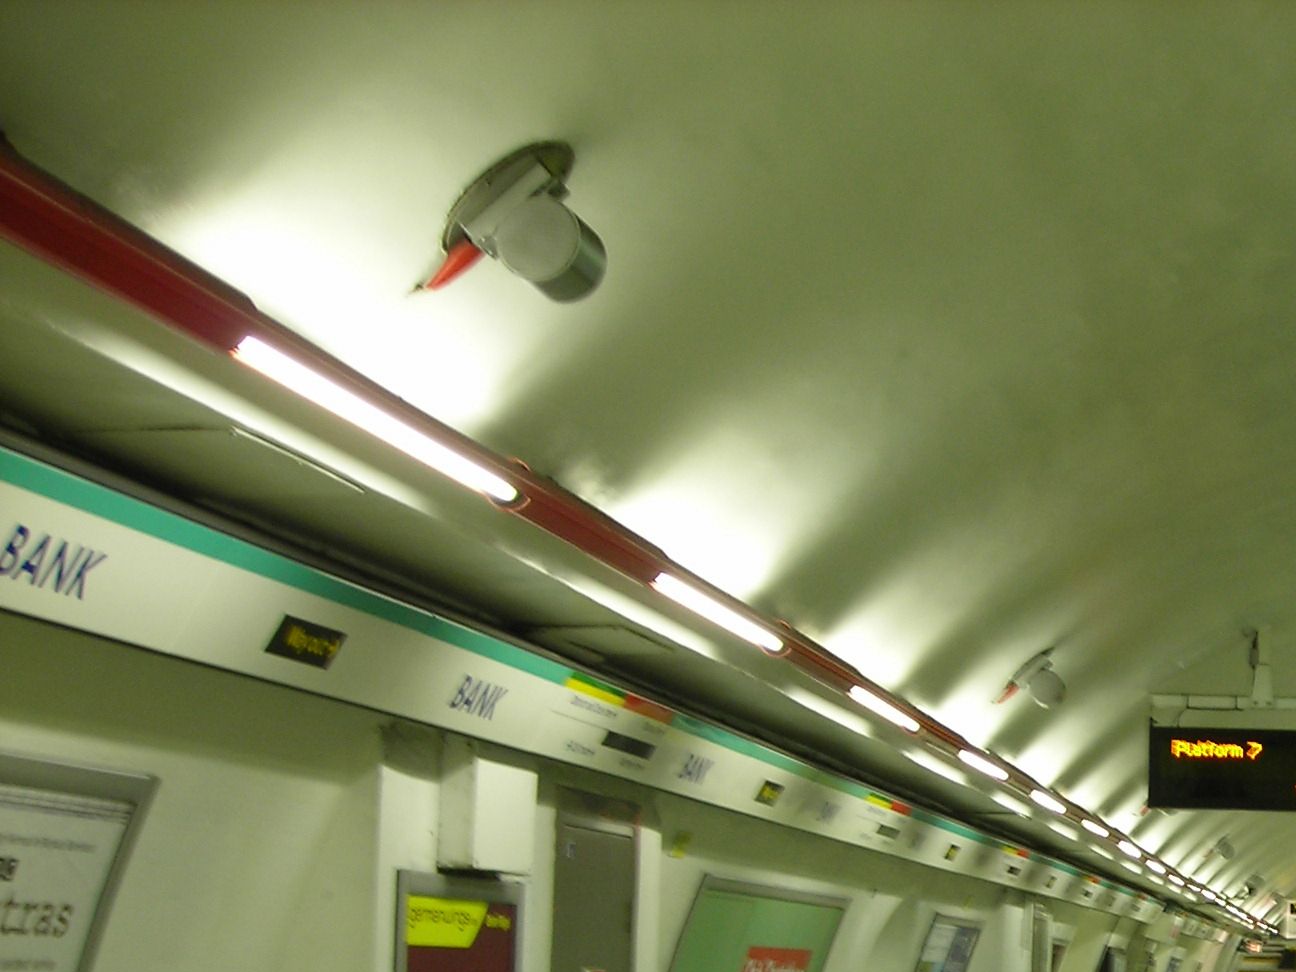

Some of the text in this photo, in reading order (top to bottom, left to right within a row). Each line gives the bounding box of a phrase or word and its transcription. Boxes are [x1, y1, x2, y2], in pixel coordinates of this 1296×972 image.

[0, 524, 108, 600] BANK
[449, 675, 509, 721] BANK
[1171, 739, 1263, 760] Platform 7
